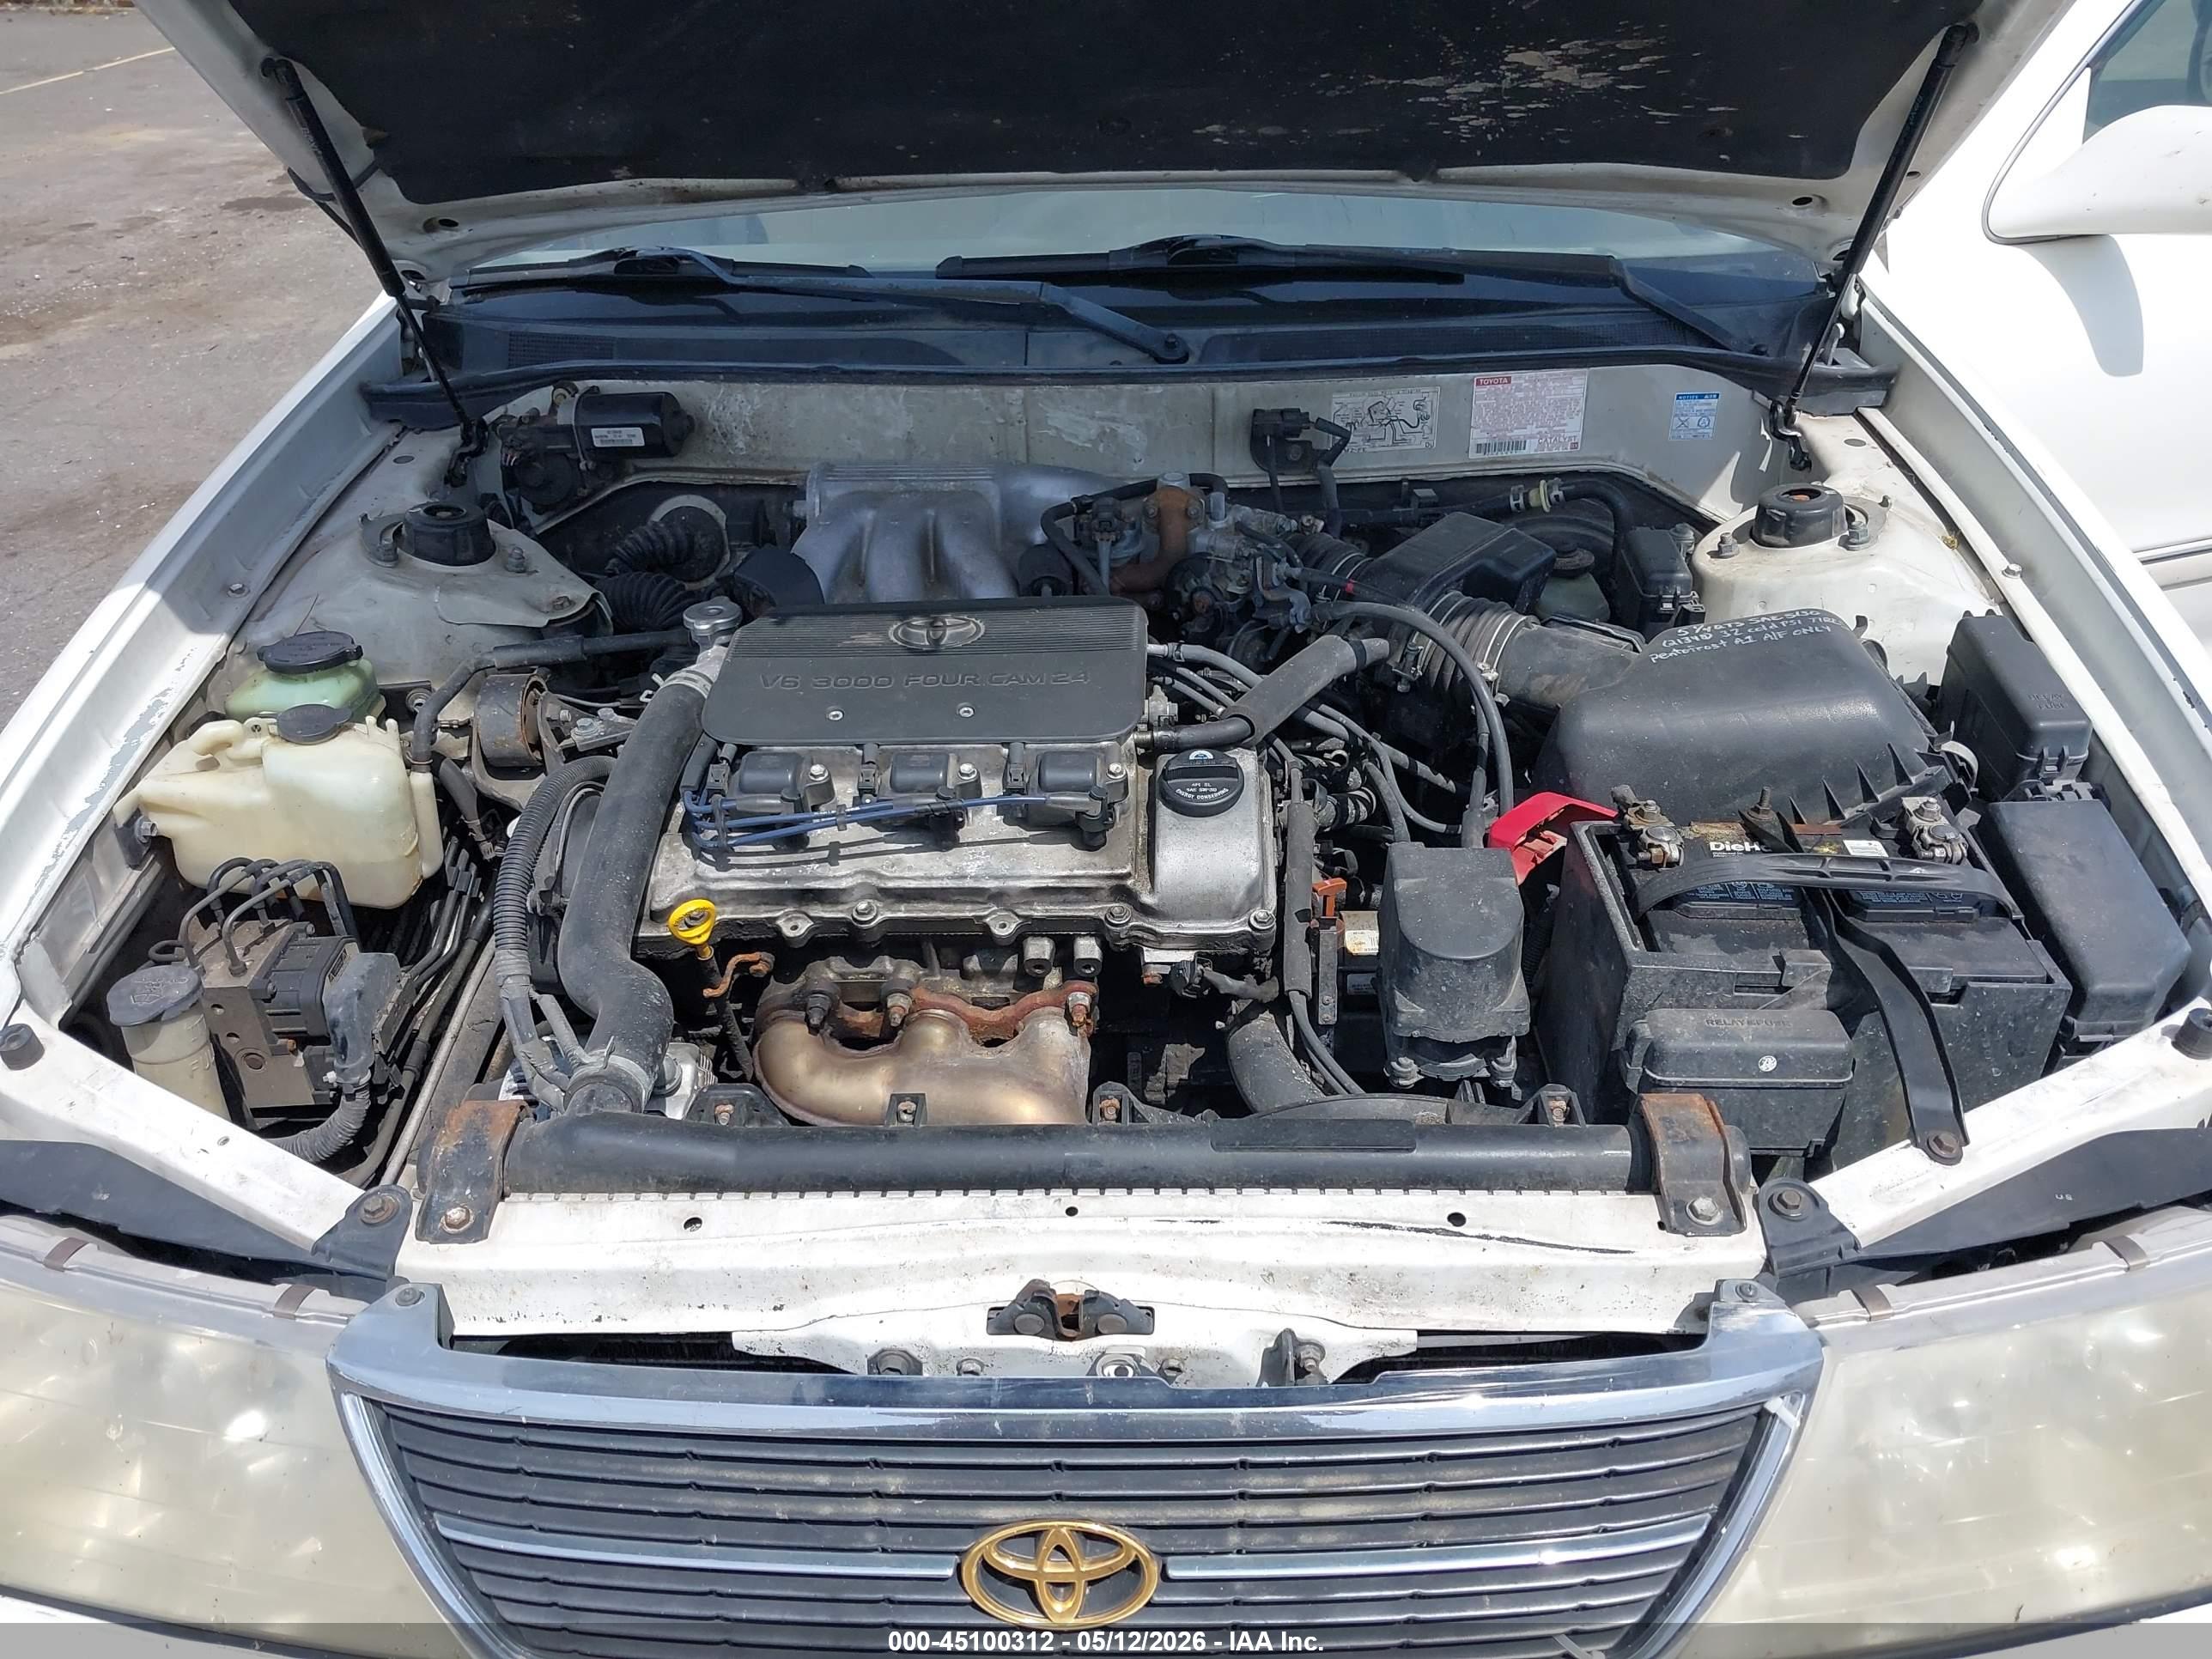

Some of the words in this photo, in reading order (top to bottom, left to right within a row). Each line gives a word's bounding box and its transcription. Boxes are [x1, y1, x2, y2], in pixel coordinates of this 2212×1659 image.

[1480, 377, 1508, 386] TOYOTA
[1538, 435, 1577, 446] CATALYST
[1720, 629, 1744, 637] 32
[1792, 625, 1832, 636] ONLY
[760, 674, 800, 689] V6
[811, 674, 895, 690] 3000
[903, 672, 980, 688] FOUR
[987, 672, 1046, 686] CAM
[1050, 672, 1091, 685] 24
